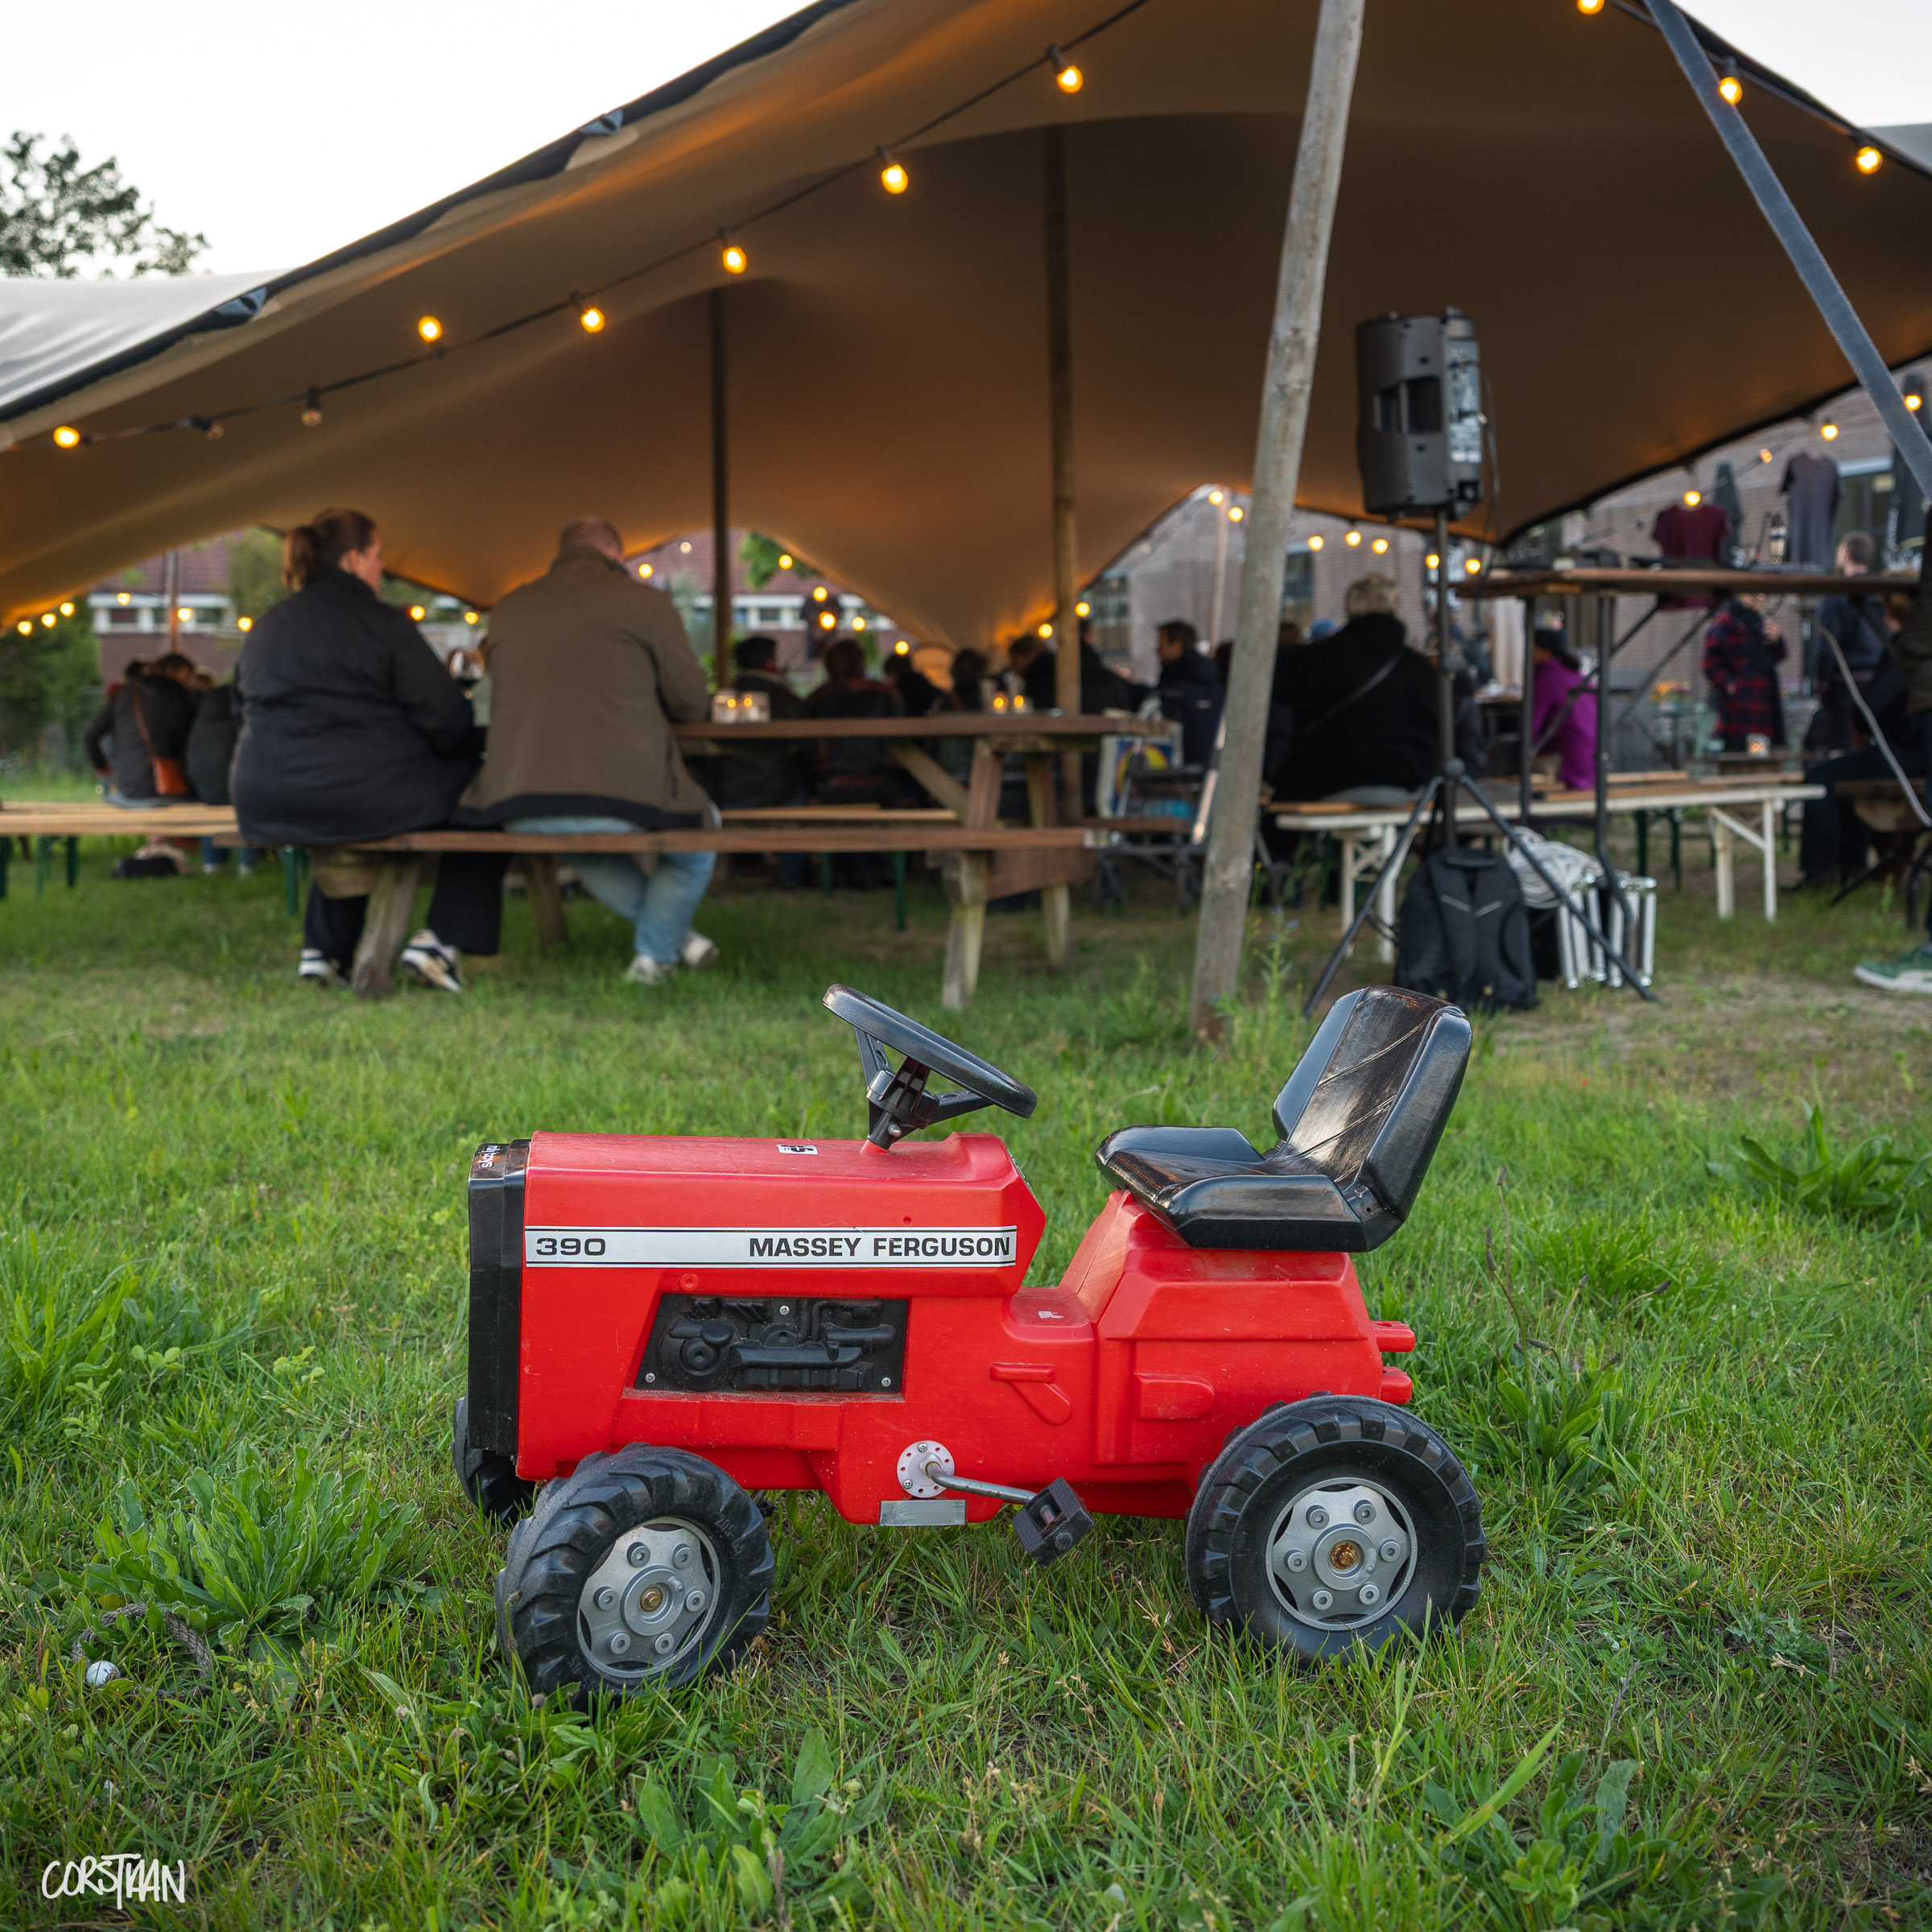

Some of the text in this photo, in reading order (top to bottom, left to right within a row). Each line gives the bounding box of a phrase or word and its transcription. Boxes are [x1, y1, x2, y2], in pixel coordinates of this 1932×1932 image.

[536, 1238, 605, 1256] 390
[749, 1236, 1010, 1257] MASSEY FERGUSON
